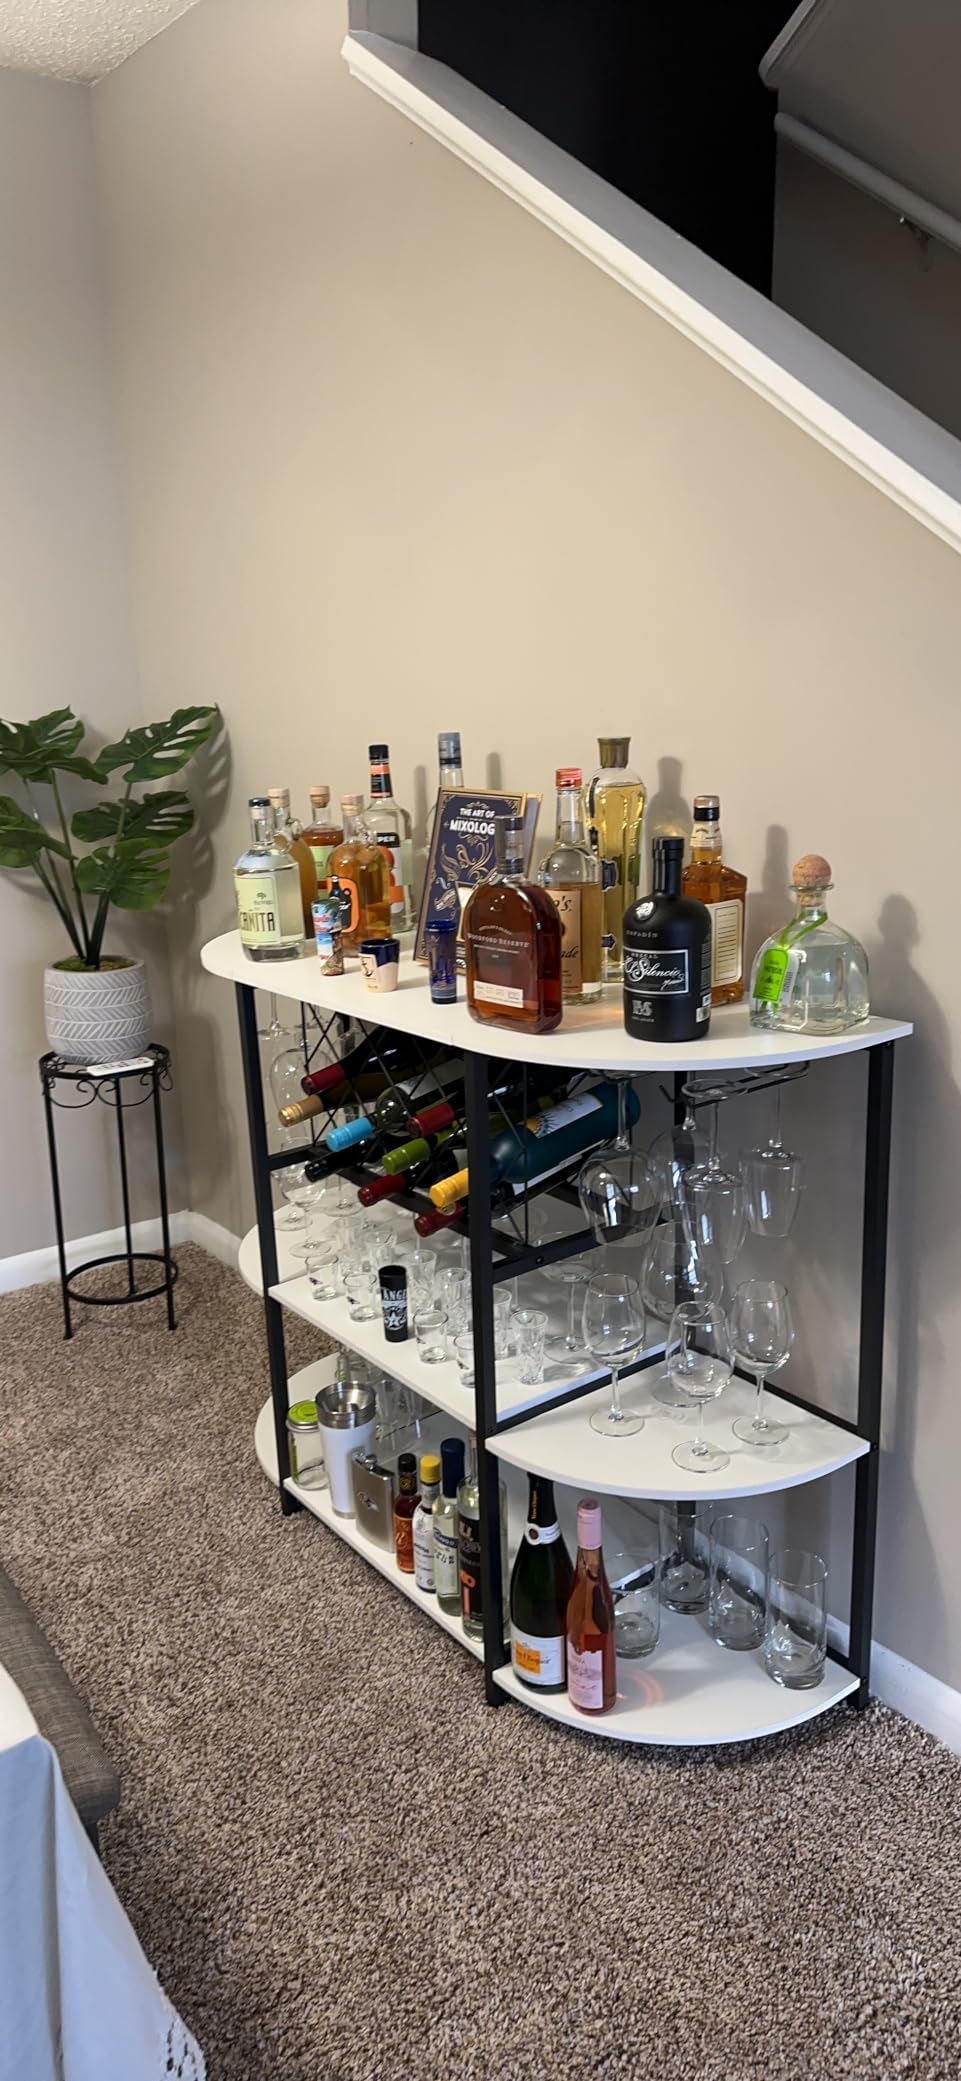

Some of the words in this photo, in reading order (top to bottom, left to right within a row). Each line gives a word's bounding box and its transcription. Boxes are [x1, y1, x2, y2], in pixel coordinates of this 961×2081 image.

[460, 807, 472, 817] THE
[472, 809, 485, 818] ART
[485, 810, 495, 819] OF
[449, 819, 496, 836] MIXOLOG
[628, 957, 681, 982] Silencio
